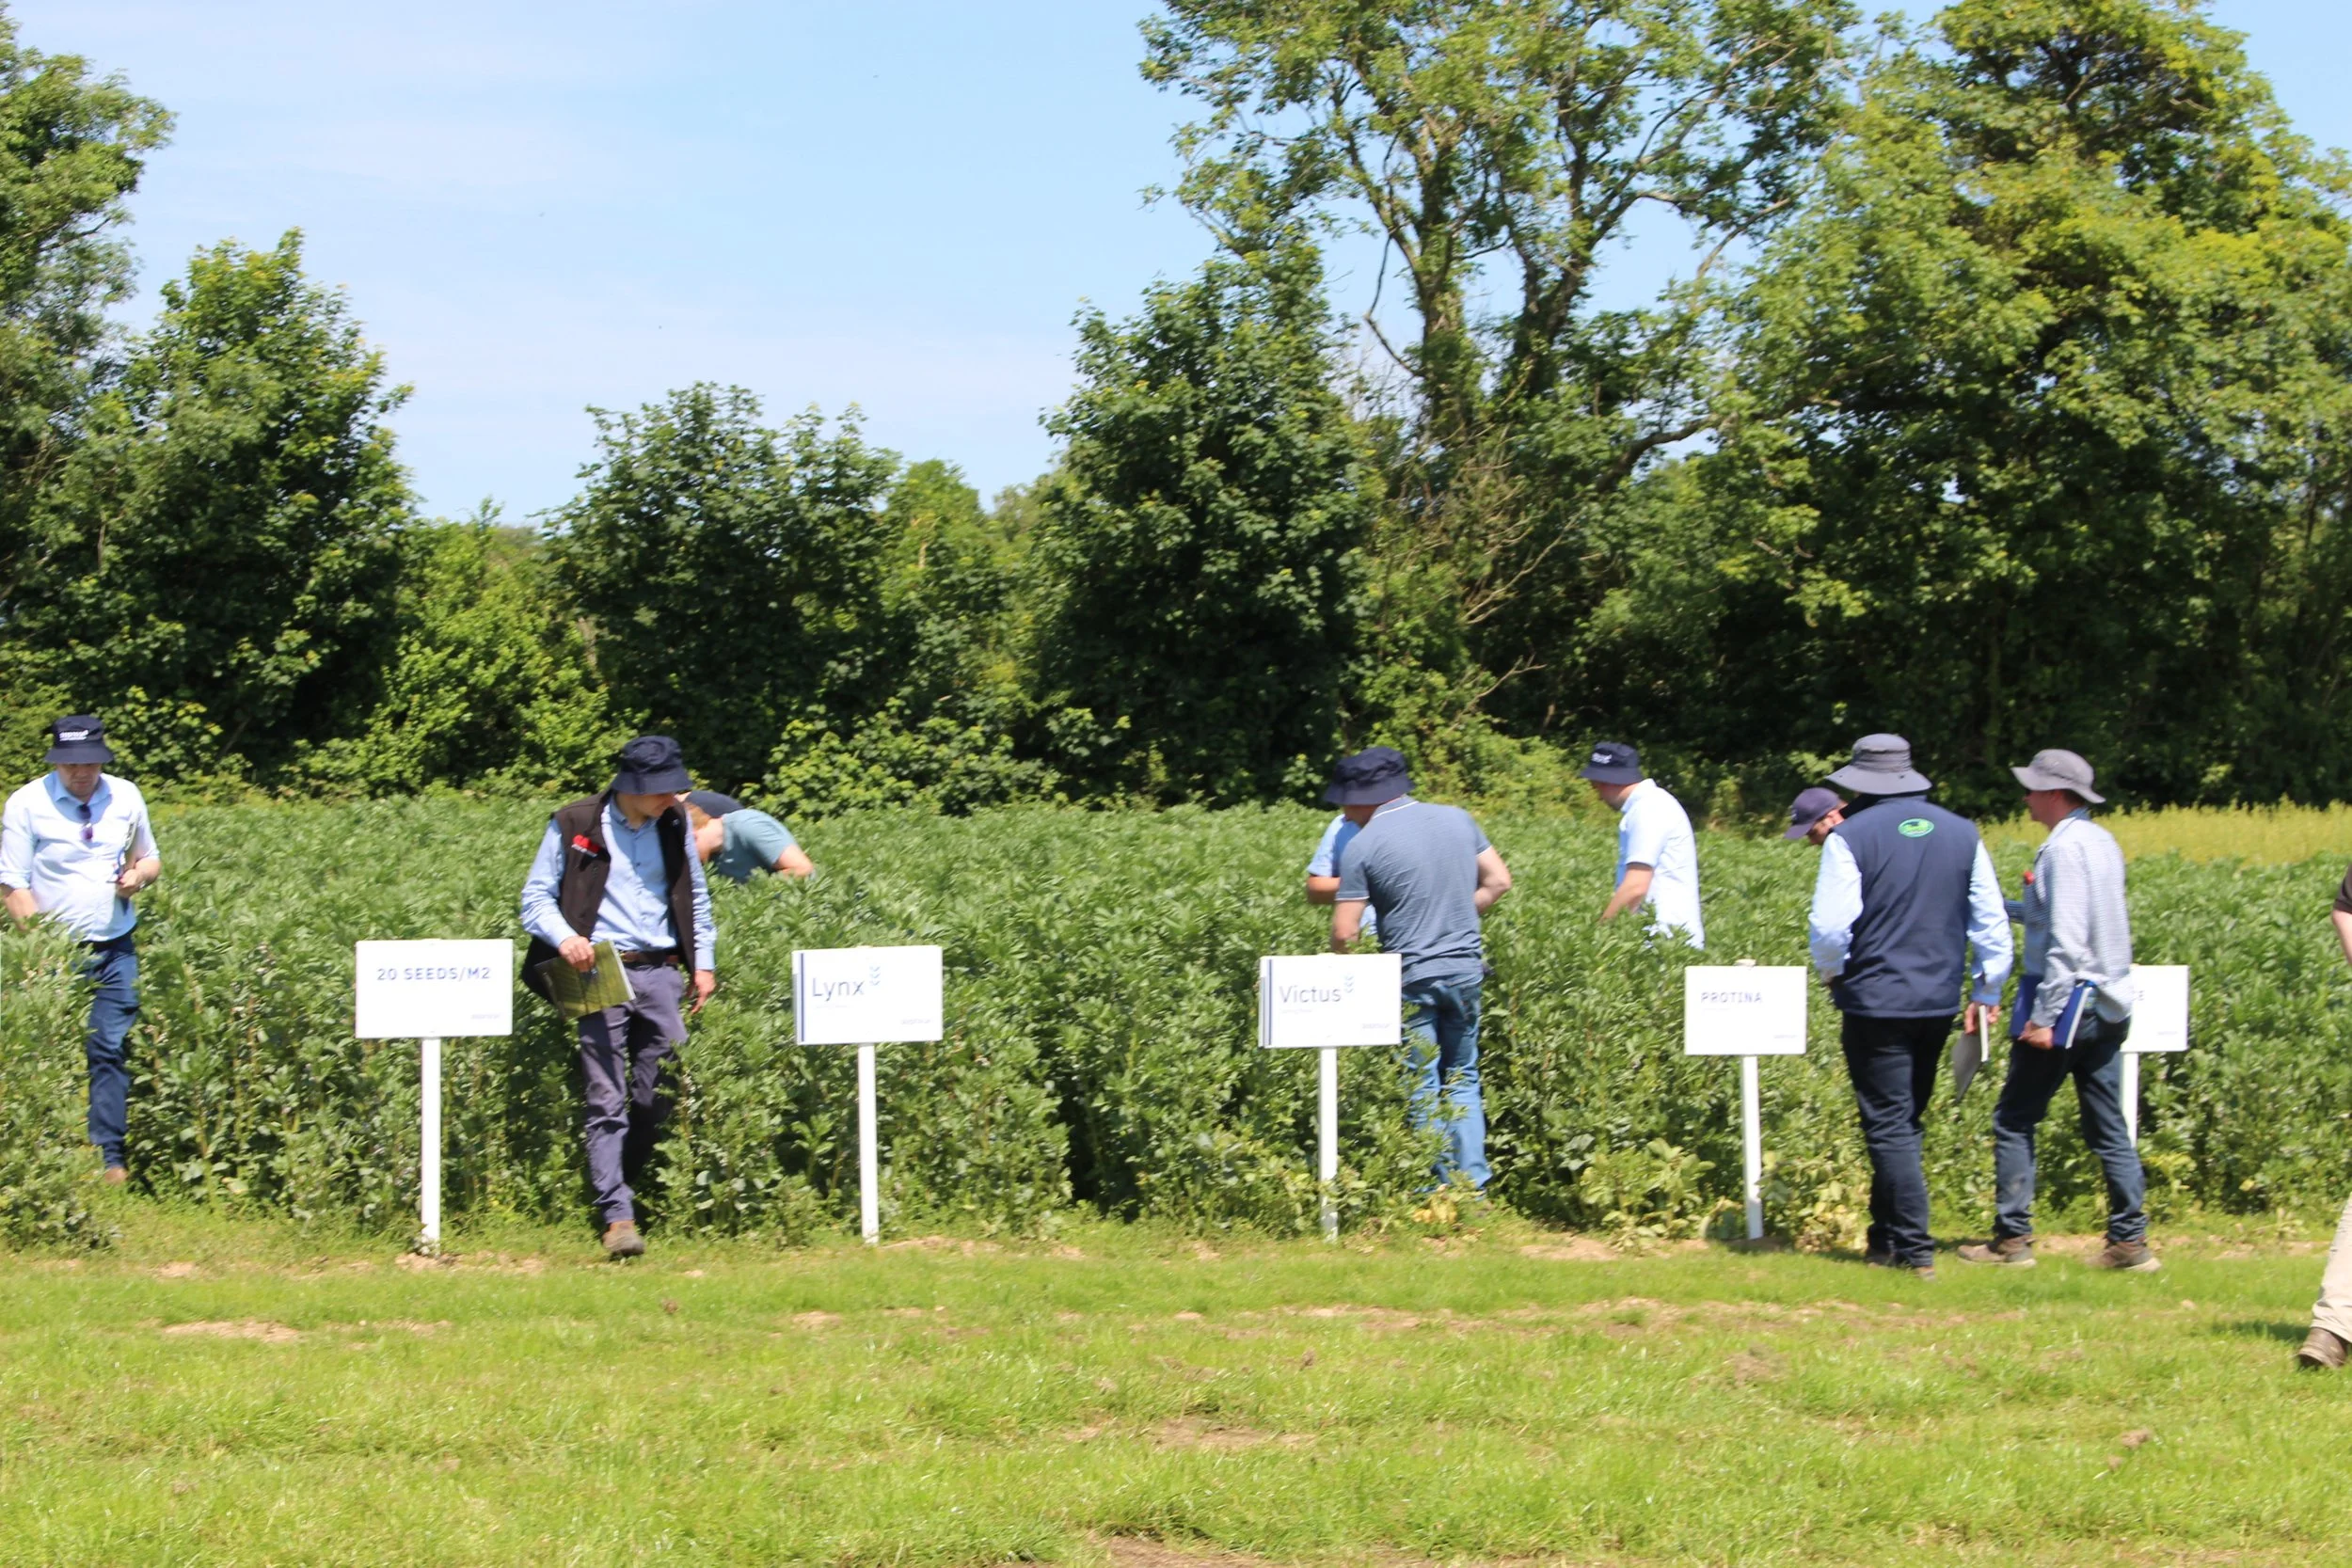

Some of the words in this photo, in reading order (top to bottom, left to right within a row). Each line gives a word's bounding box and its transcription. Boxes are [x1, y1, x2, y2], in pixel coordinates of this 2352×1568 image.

[376, 968, 397, 980] 20
[404, 967, 491, 982] SEEDS/M2
[812, 977, 865, 1002] Lynx
[1279, 985, 1342, 1003] Victus
[1701, 991, 1762, 1003] PROTINA
